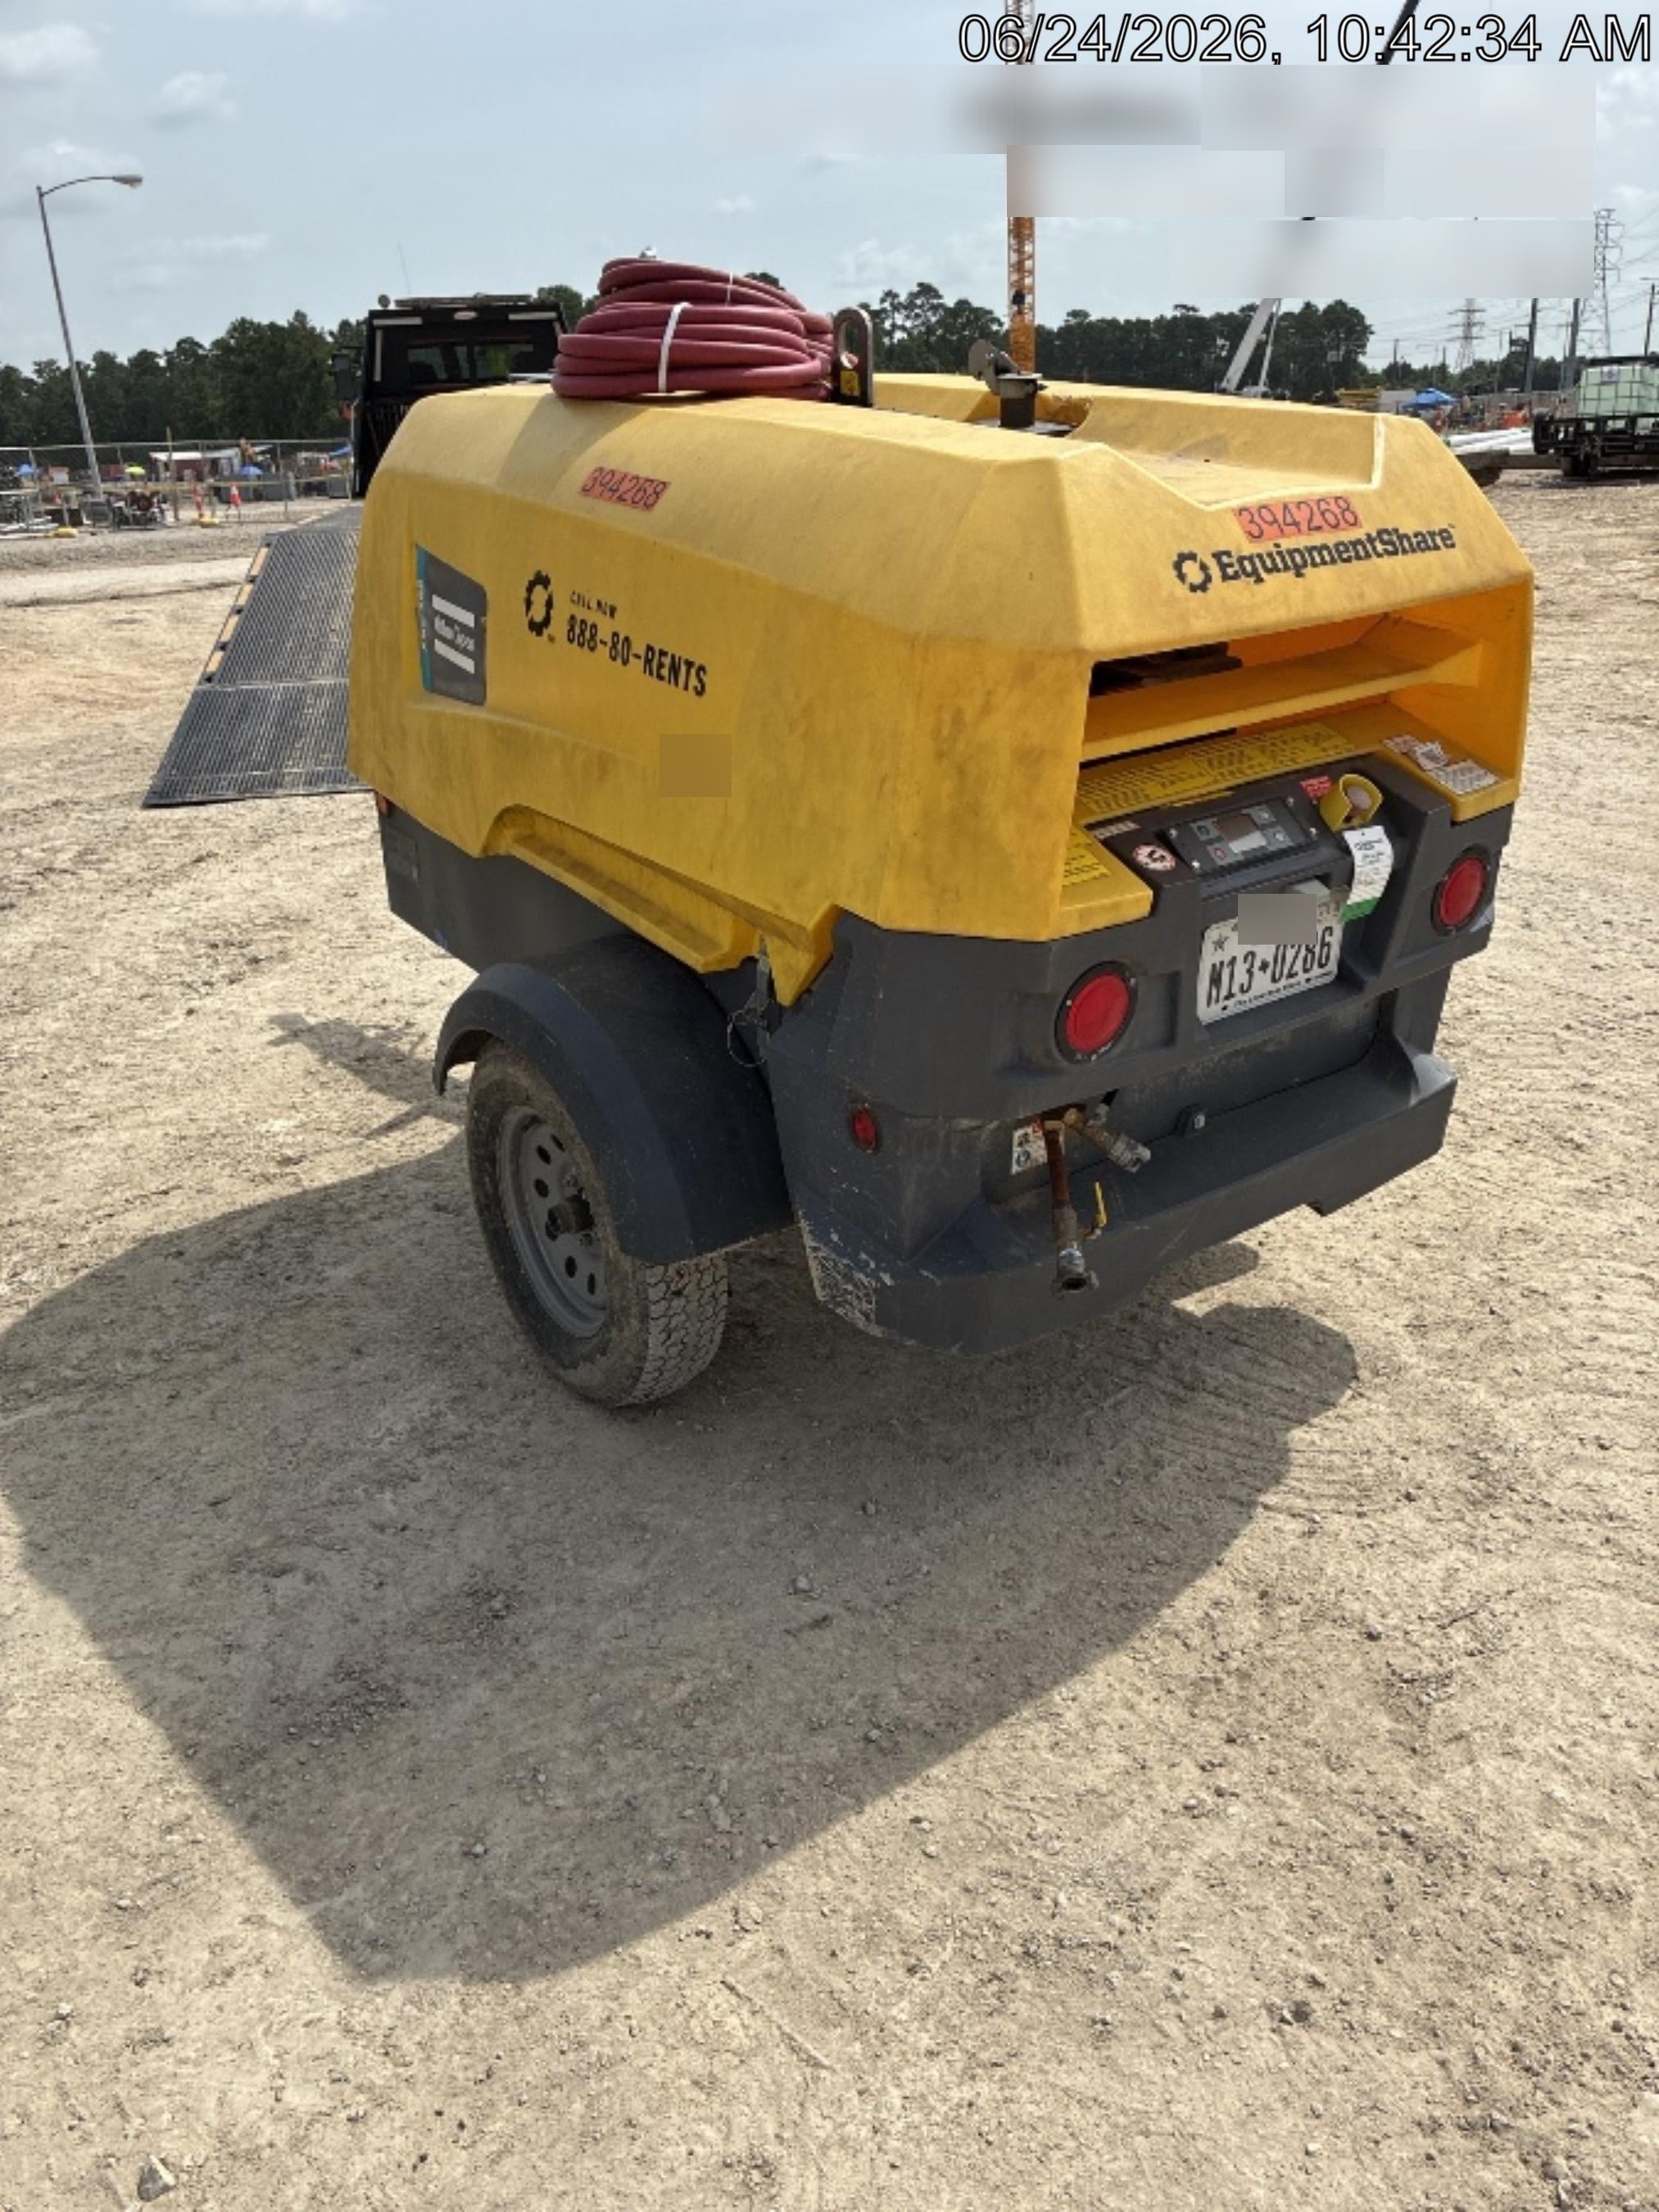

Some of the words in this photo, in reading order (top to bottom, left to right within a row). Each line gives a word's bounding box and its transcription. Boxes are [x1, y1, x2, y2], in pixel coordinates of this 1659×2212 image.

[581, 466, 669, 510] 394268
[1237, 496, 1359, 540] 394268
[1212, 525, 1456, 585] EquipmentShare
[567, 614, 708, 697] 888-80-RENTS
